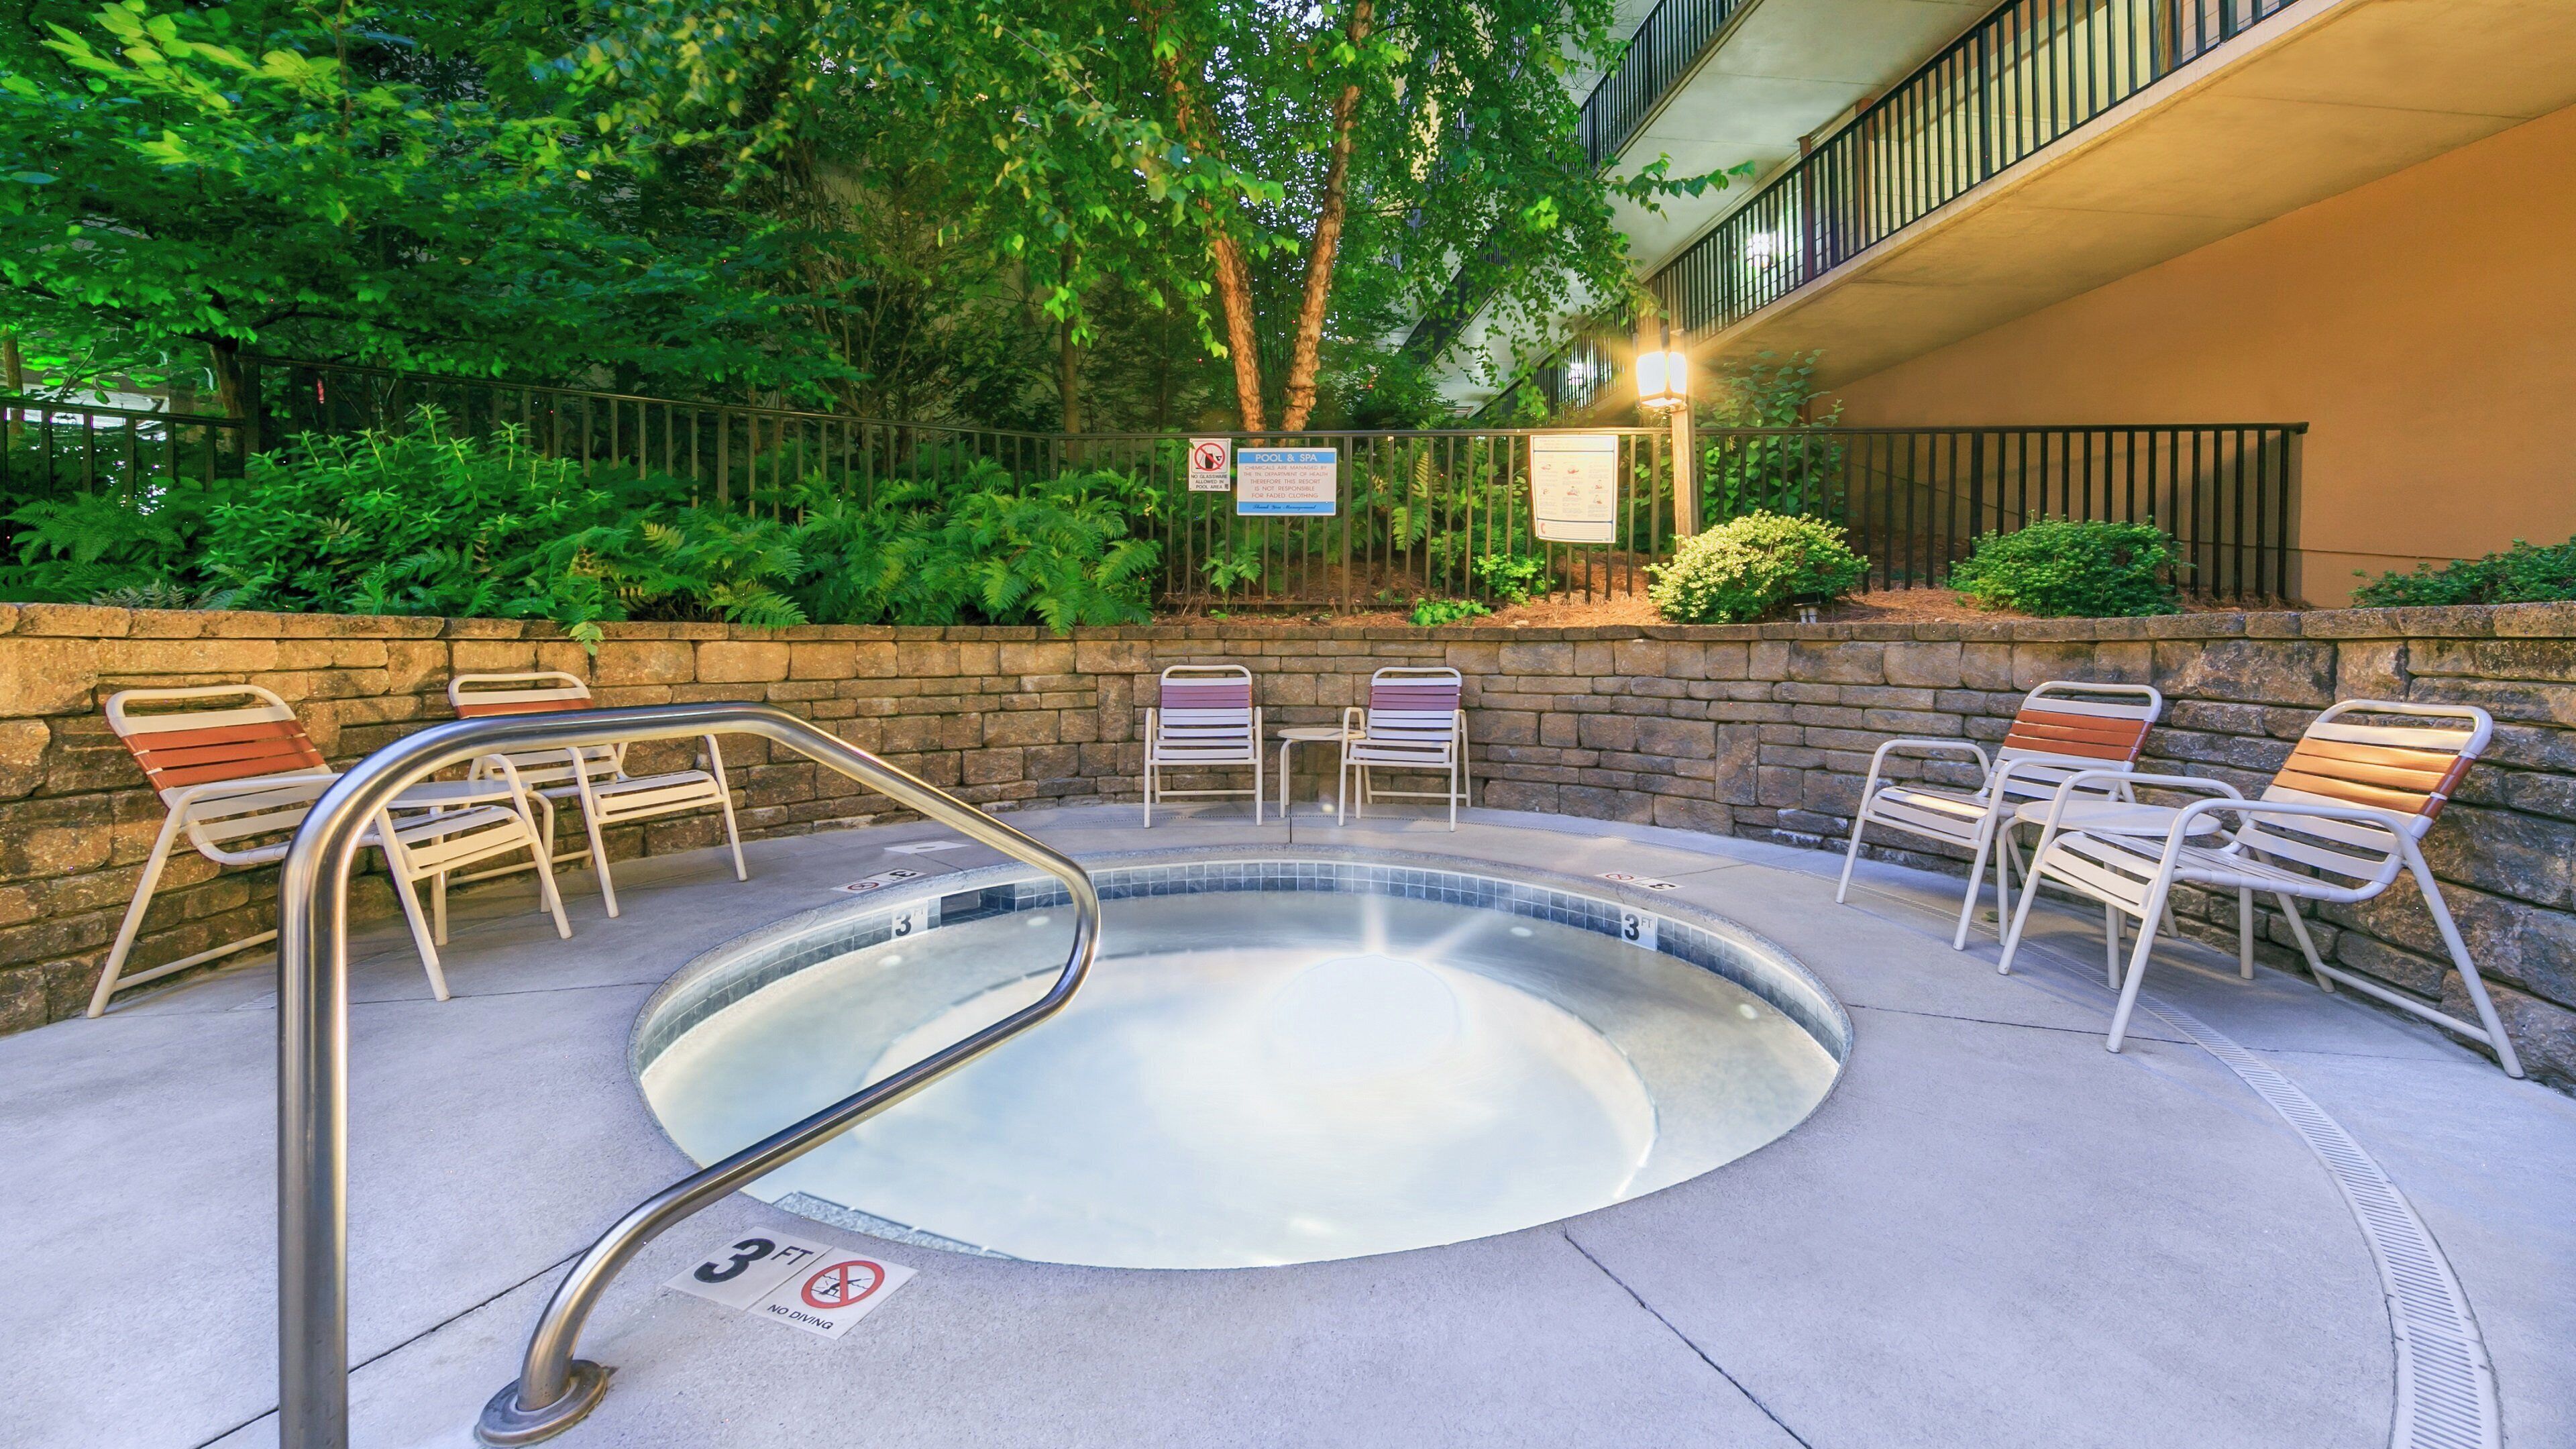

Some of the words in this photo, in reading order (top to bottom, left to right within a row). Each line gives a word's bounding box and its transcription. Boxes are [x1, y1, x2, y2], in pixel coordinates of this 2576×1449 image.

[1255, 453, 1283, 462] POOL
[1287, 453, 1295, 462] &
[1299, 453, 1318, 462] SPA
[896, 910, 912, 936] 3
[1624, 914, 1640, 941] 3
[693, 1238, 775, 1283] 3
[770, 1246, 814, 1265] FT
[767, 1303, 788, 1316] NO
[788, 1311, 834, 1330] DIVING
